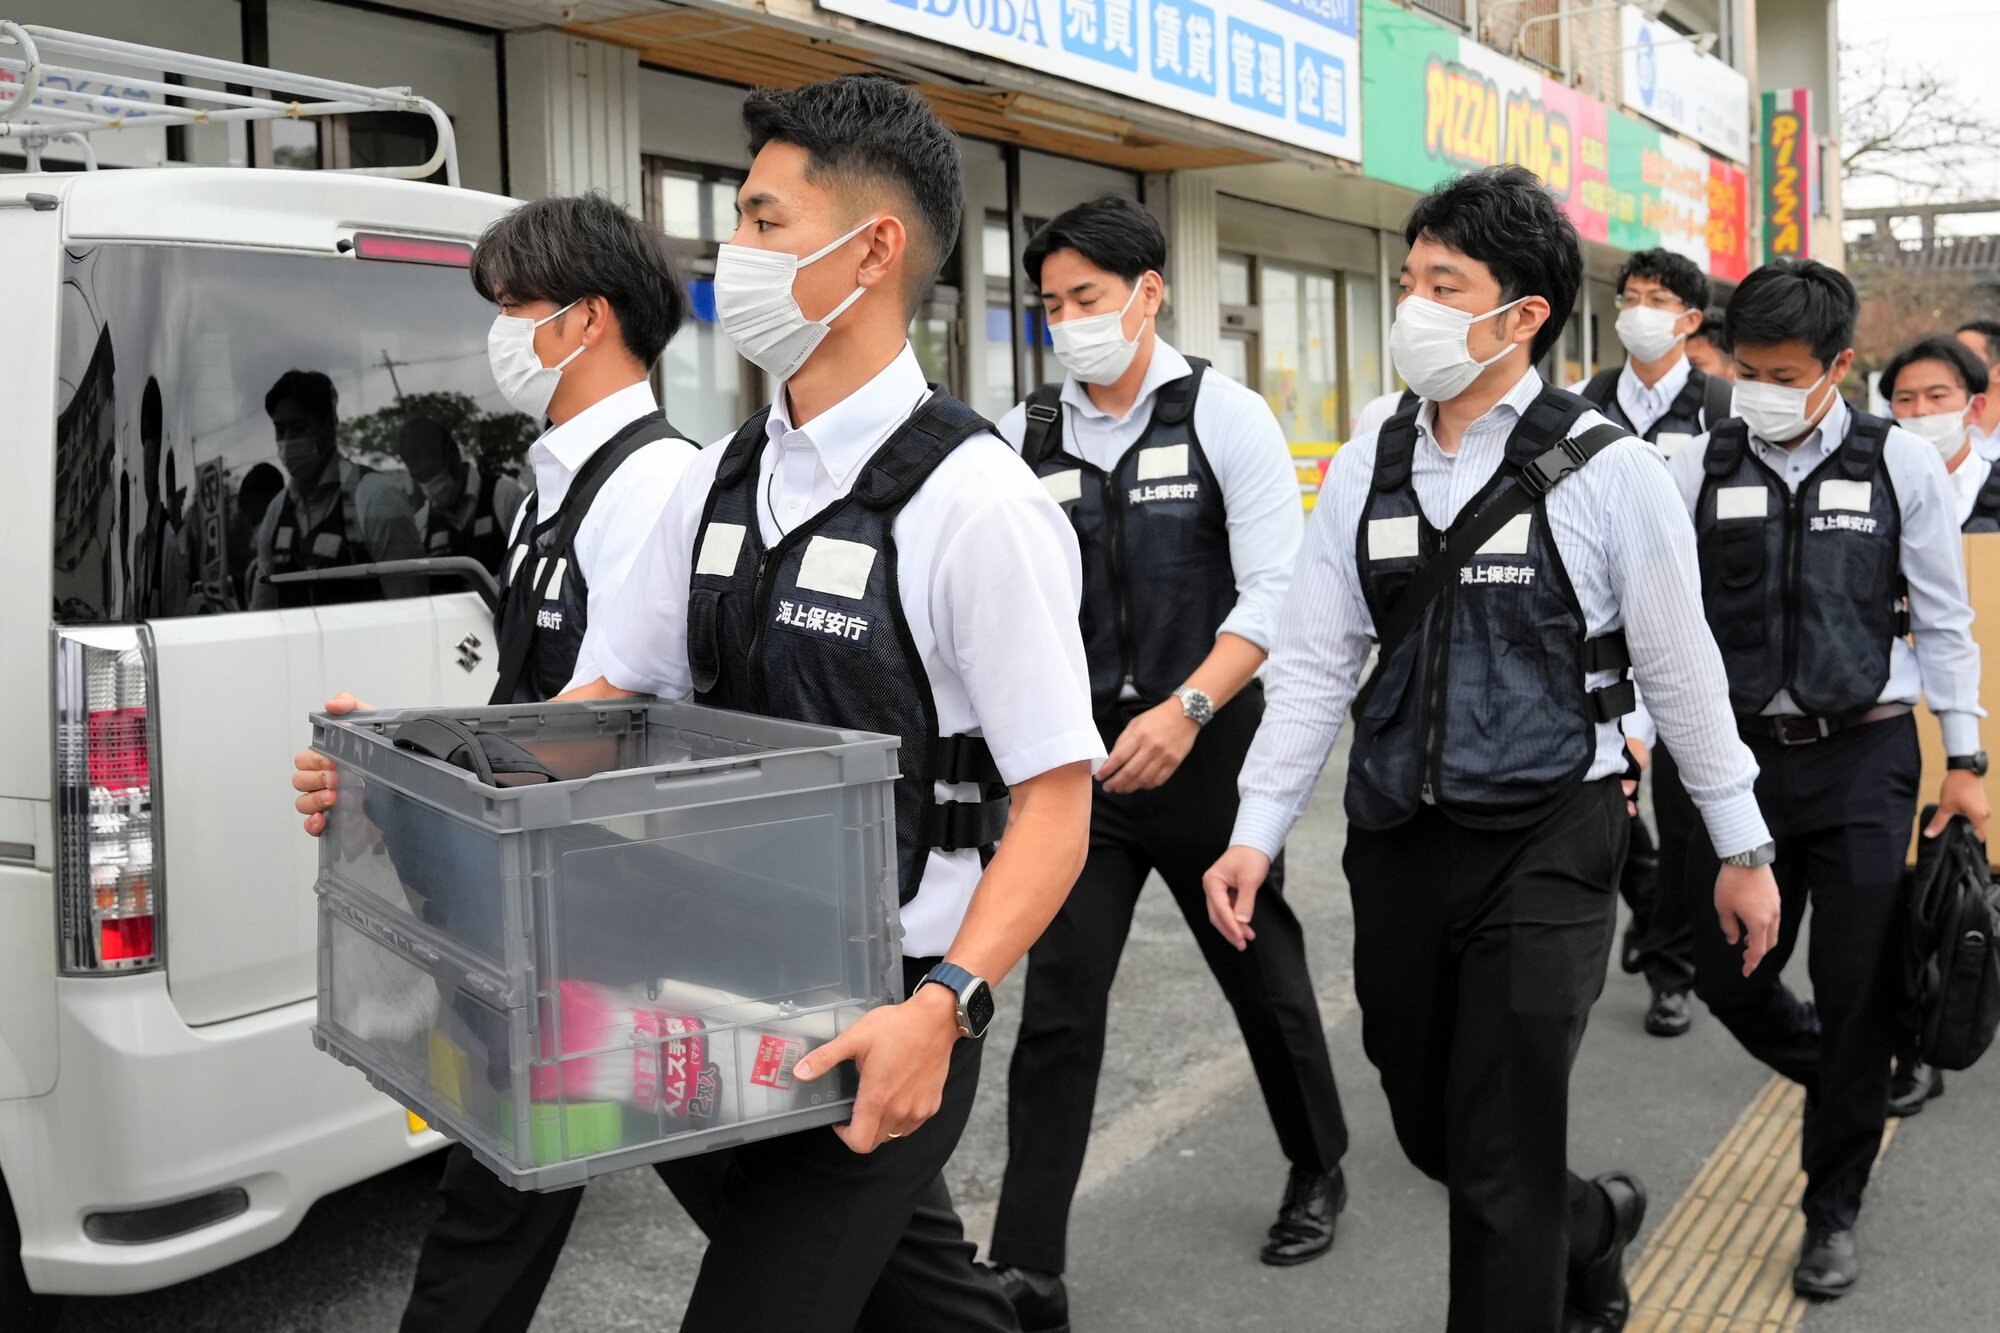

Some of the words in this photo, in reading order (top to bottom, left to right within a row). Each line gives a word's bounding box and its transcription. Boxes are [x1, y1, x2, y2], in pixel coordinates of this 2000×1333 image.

[1154, 3, 1213, 85] 賃貸
[1231, 29, 1283, 107] 管理
[1298, 56, 1344, 126] 企画
[1426, 62, 1498, 168] PIZZA
[1771, 114, 1799, 254] PIZZA
[1129, 483, 1198, 504] 海上保安庁
[1809, 514, 1877, 533] 海上保安庁
[1460, 565, 1535, 584] 海上保安庁
[775, 600, 868, 640] 海上保安庁
[759, 1067, 777, 1083] L
